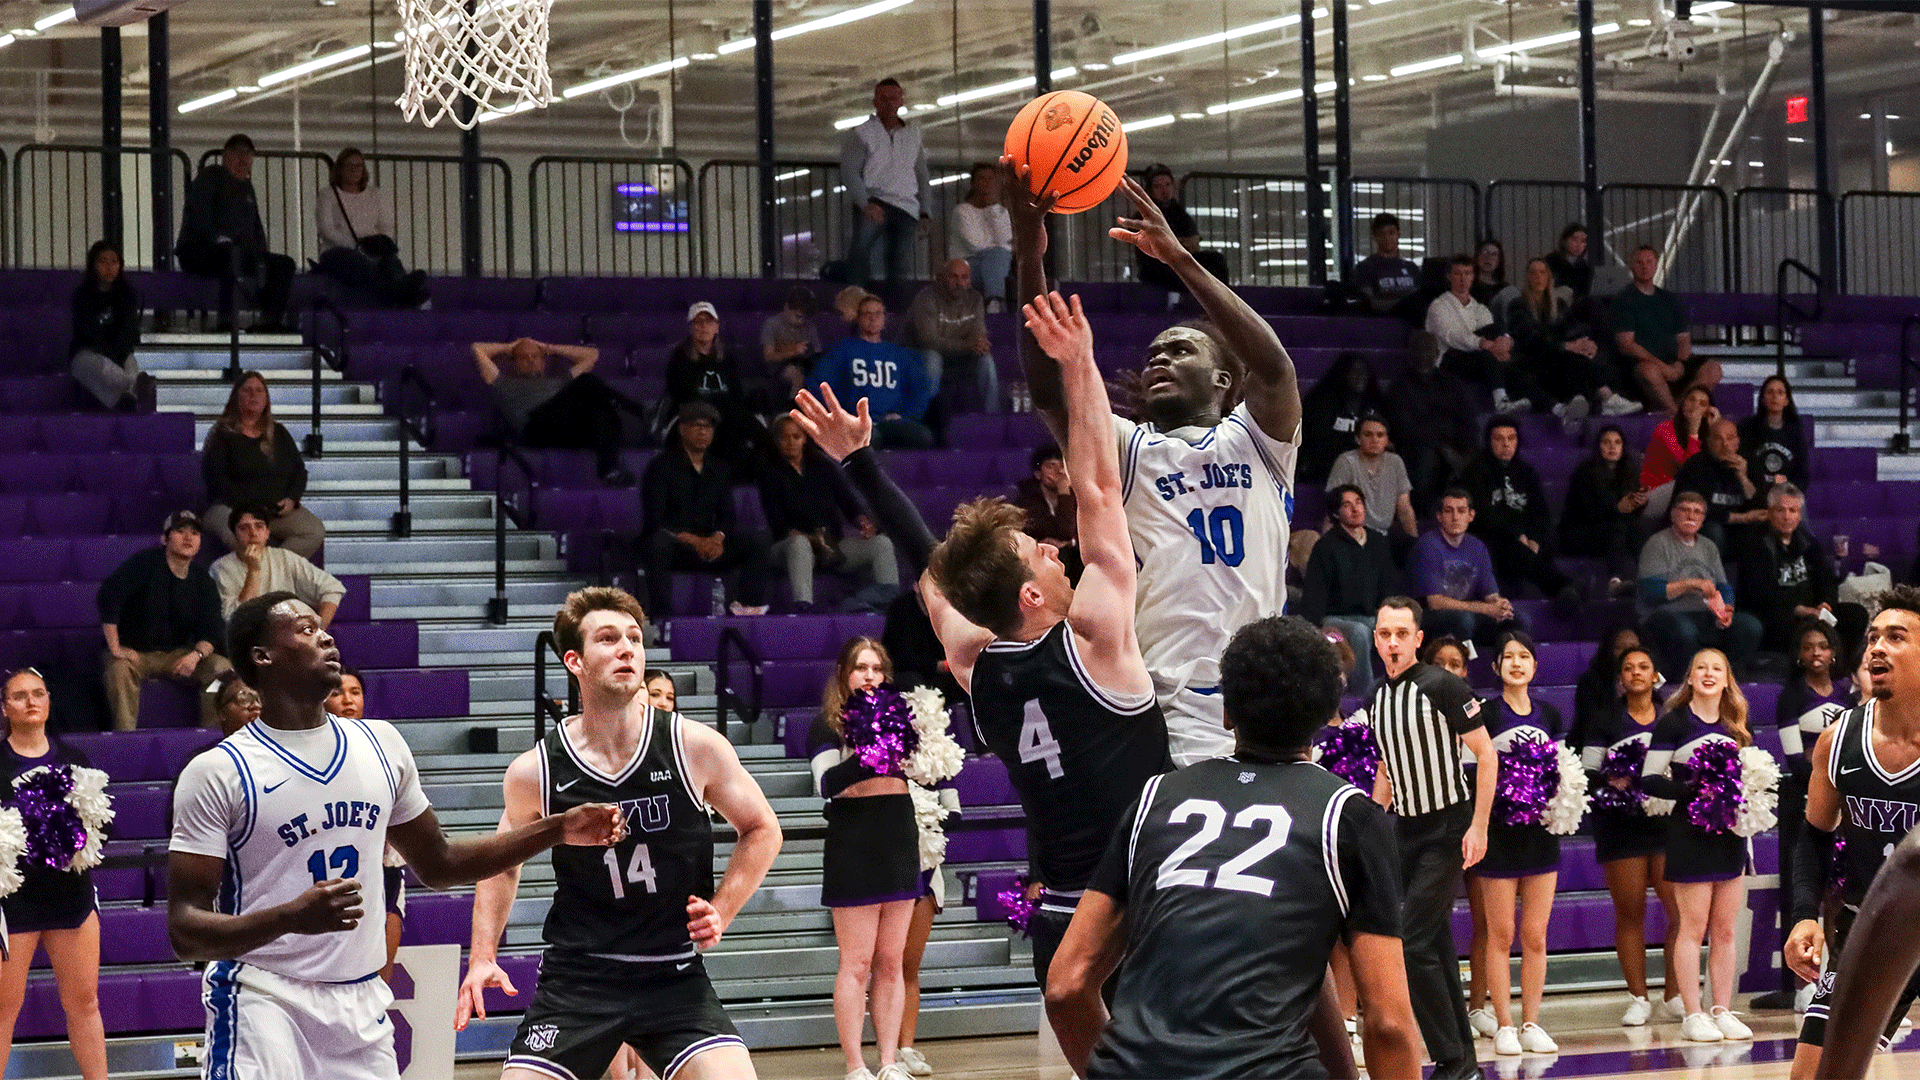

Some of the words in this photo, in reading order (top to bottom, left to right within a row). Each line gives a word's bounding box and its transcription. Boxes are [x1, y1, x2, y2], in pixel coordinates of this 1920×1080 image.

[1066, 110, 1118, 174] Wilson
[852, 358, 897, 390] SJC
[1155, 471, 1195, 501] ST.
[1200, 463, 1252, 490] JOE'S
[1186, 505, 1245, 567] 10
[1018, 698, 1064, 779] 4
[650, 769, 672, 782] UAA
[277, 813, 317, 848] ST.
[322, 801, 380, 830] JOE'S
[1156, 799, 1292, 897] 22
[307, 845, 359, 884] 12
[603, 844, 657, 899] 14
